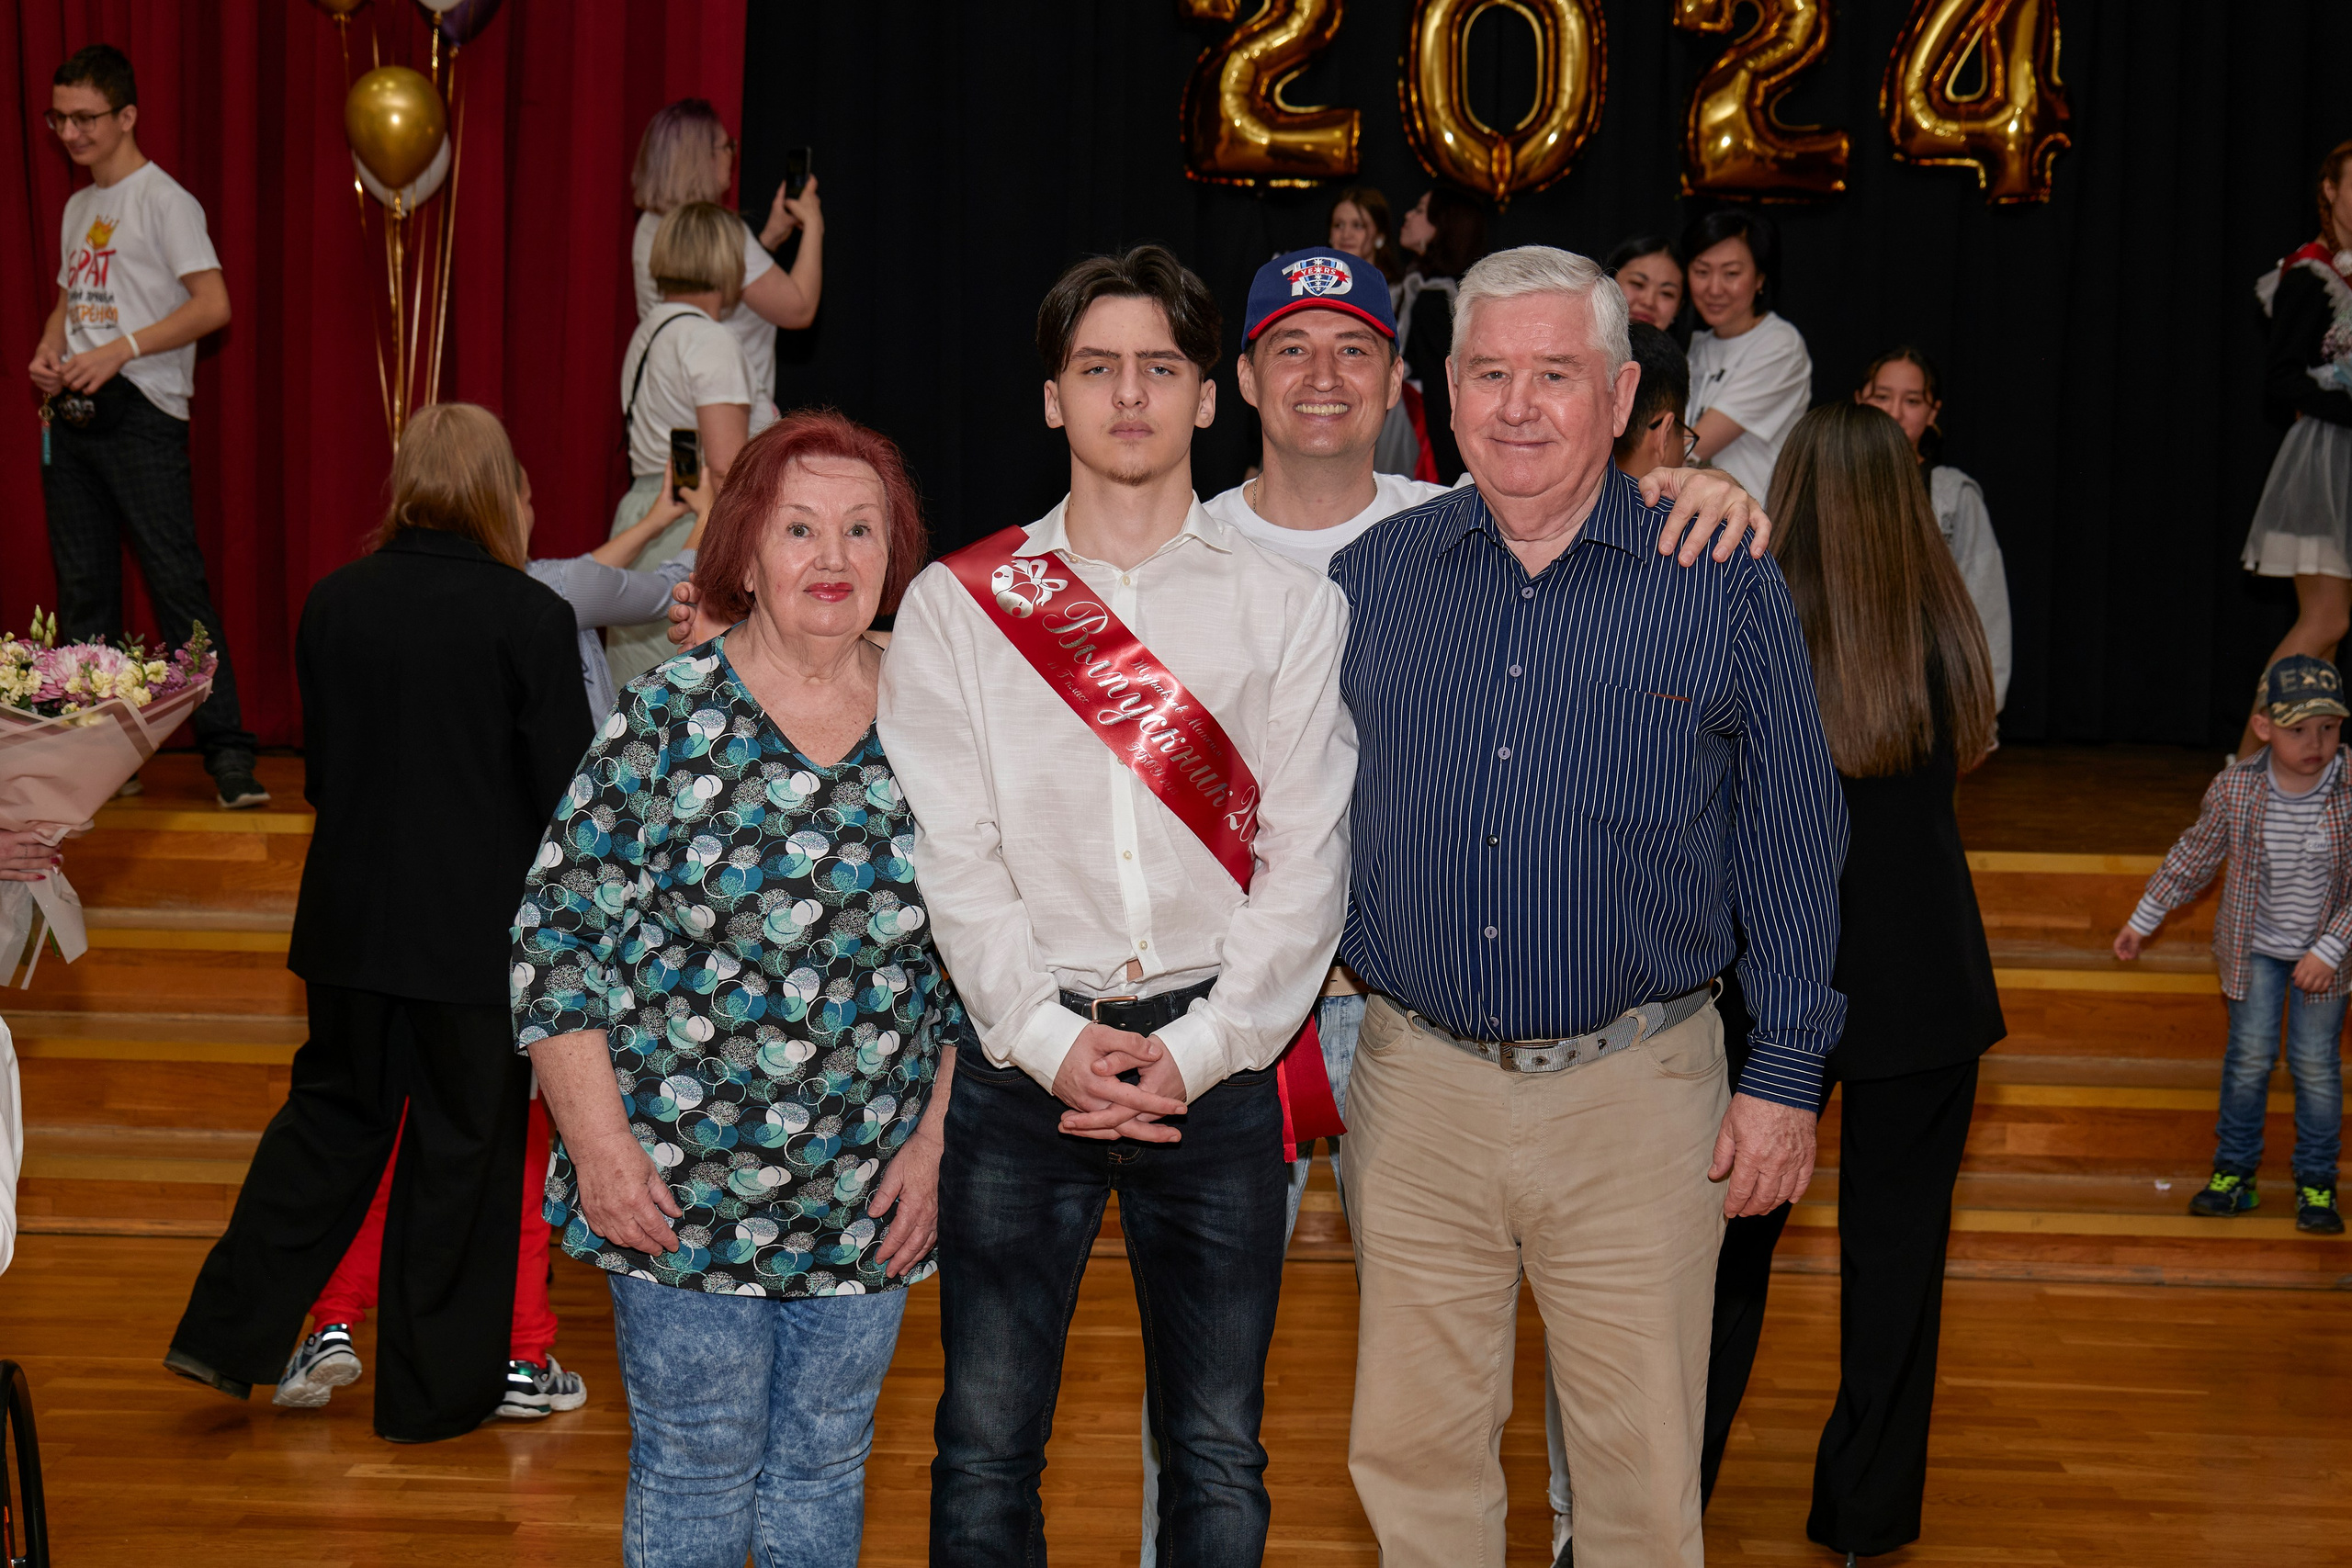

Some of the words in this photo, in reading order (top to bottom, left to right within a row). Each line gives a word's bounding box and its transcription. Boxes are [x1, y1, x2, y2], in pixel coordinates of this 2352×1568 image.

[1180, 0, 2073, 208] 2024
[1301, 266, 1337, 276] YERS
[1042, 601, 1234, 807] Выпускник
[1065, 680, 1091, 705] класс
[1131, 657, 1190, 715] Журавлев
[1182, 715, 1223, 758] Максим
[1126, 741, 1166, 778] ГБОУ
